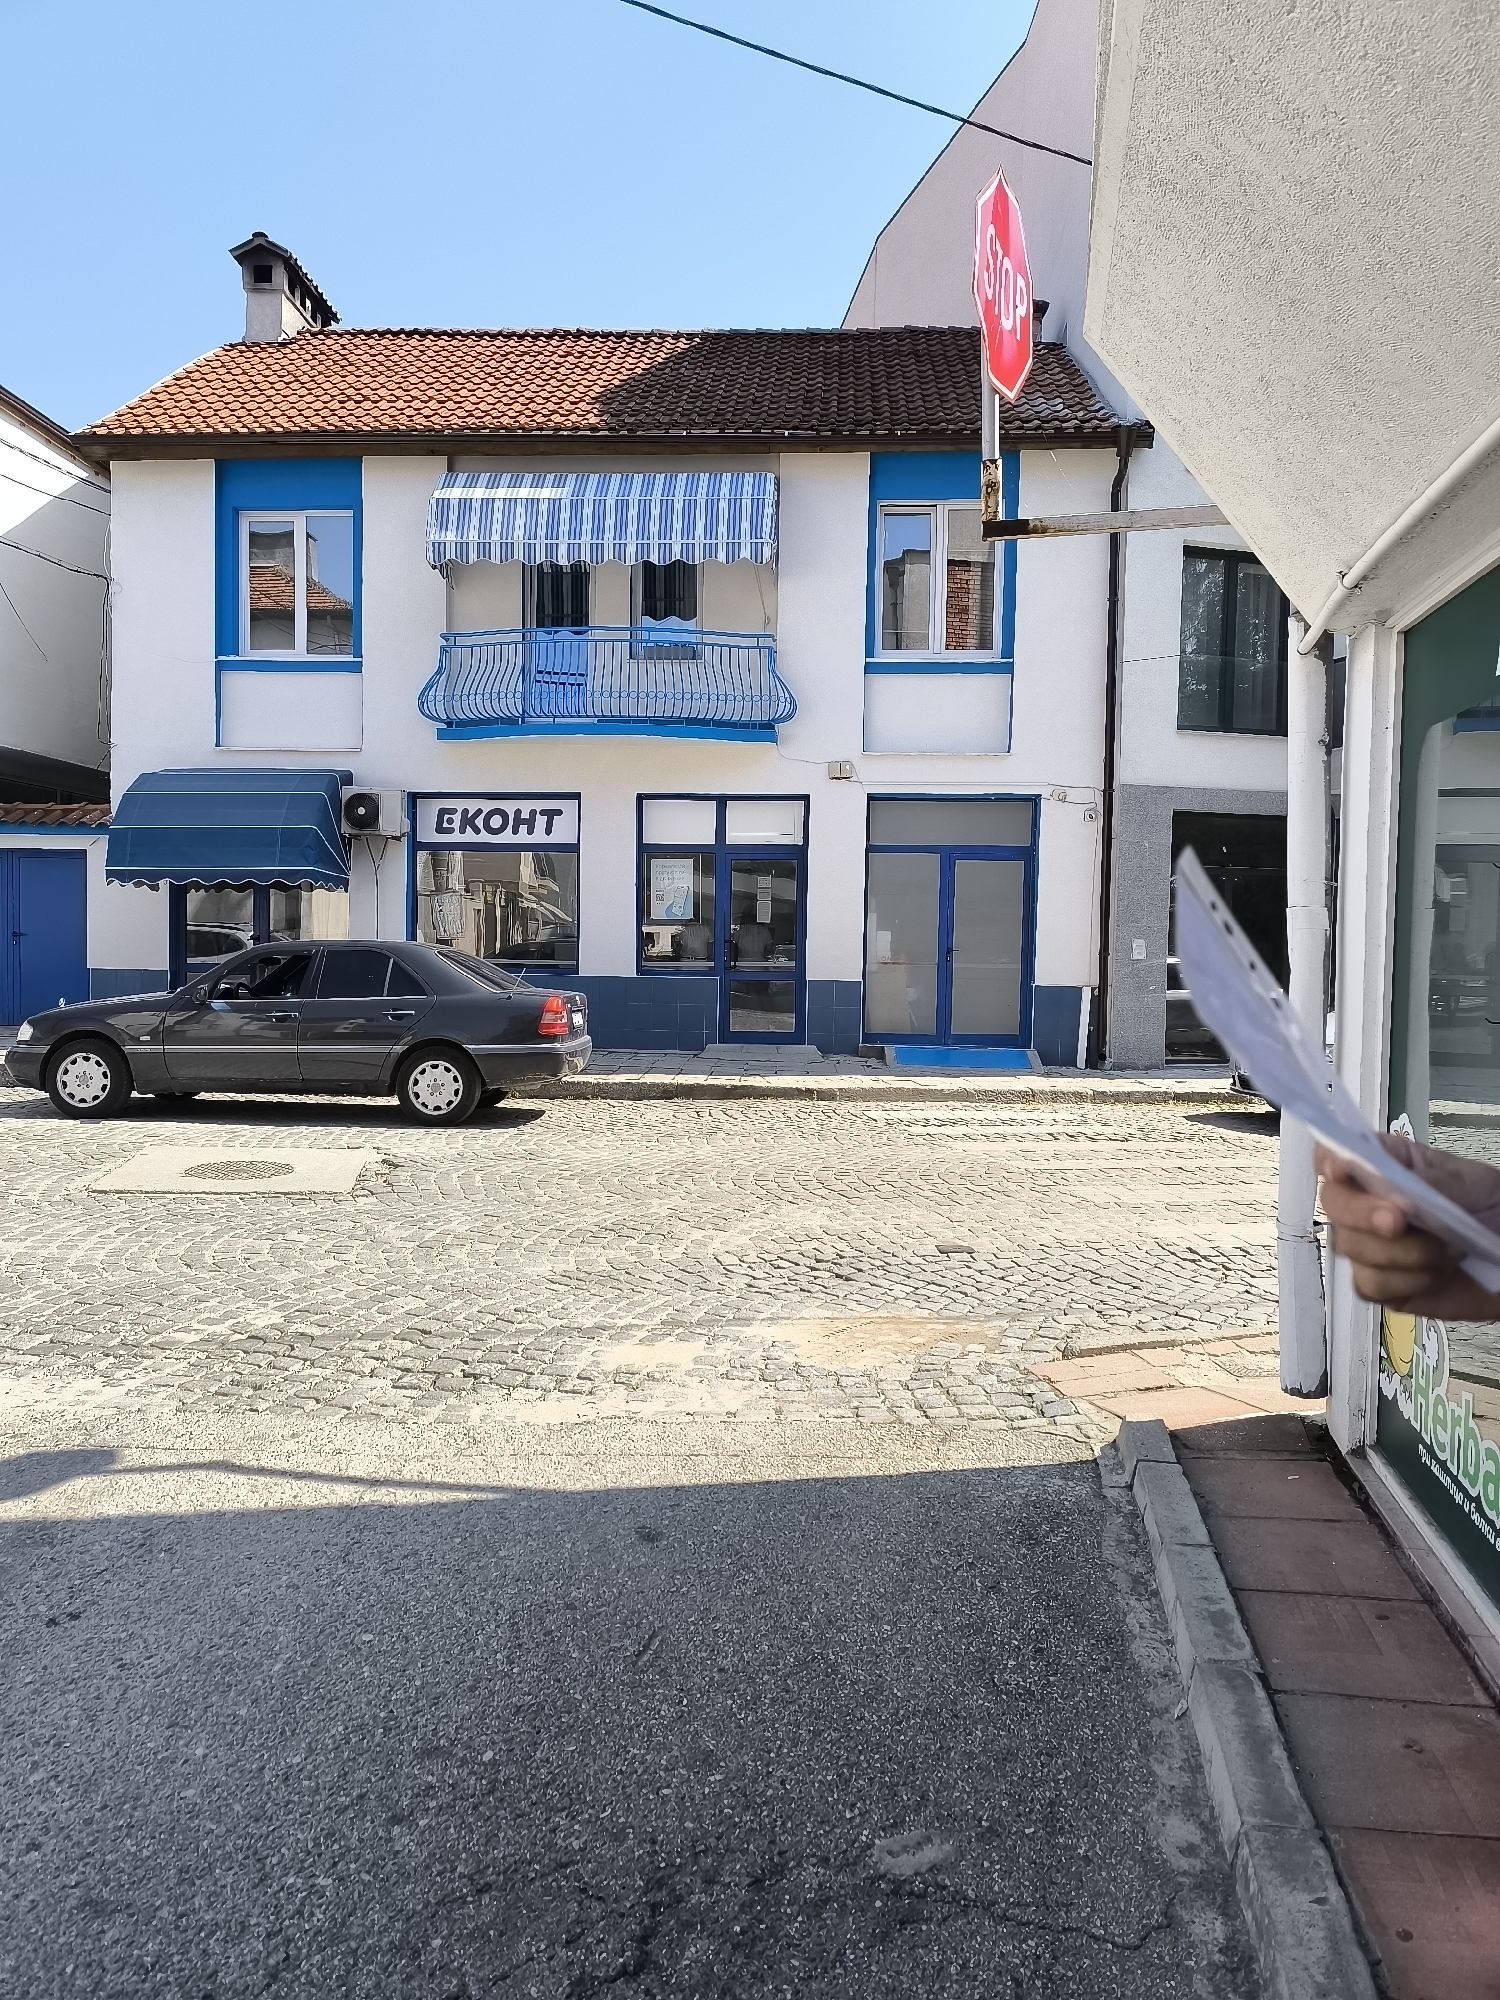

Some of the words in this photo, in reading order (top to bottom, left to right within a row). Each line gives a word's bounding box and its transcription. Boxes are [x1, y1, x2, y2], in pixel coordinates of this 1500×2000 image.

[984, 223, 1028, 341] STOP
[434, 807, 564, 836] ЕКОНТ
[1418, 1443, 1430, 1466] при
[1463, 1497, 1469, 1514] и
[1470, 1502, 1495, 1544] болки
